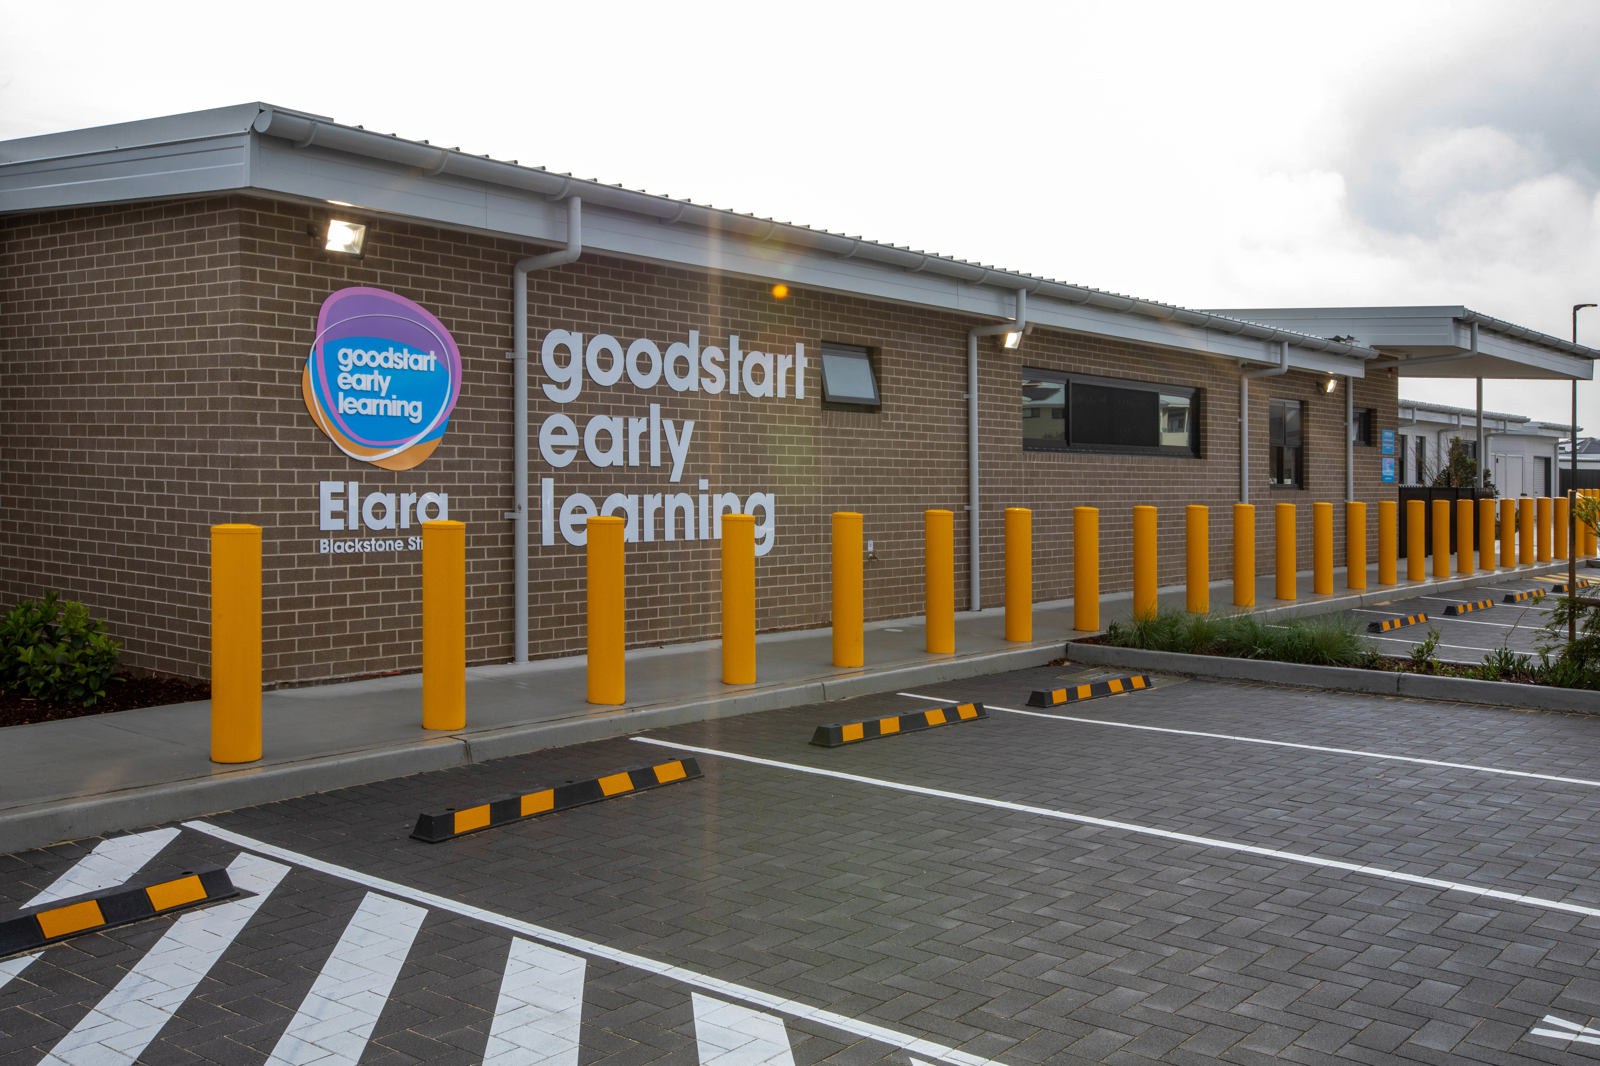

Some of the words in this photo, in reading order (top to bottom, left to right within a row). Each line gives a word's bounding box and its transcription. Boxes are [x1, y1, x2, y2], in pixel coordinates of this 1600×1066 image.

[337, 346, 437, 373] goodstart
[541, 328, 808, 404] goodstart
[337, 369, 392, 398] early
[338, 391, 423, 424] learning
[538, 403, 696, 483] early
[319, 480, 449, 531] Elara
[541, 477, 776, 557] learning
[319, 537, 404, 554] Blackstone
